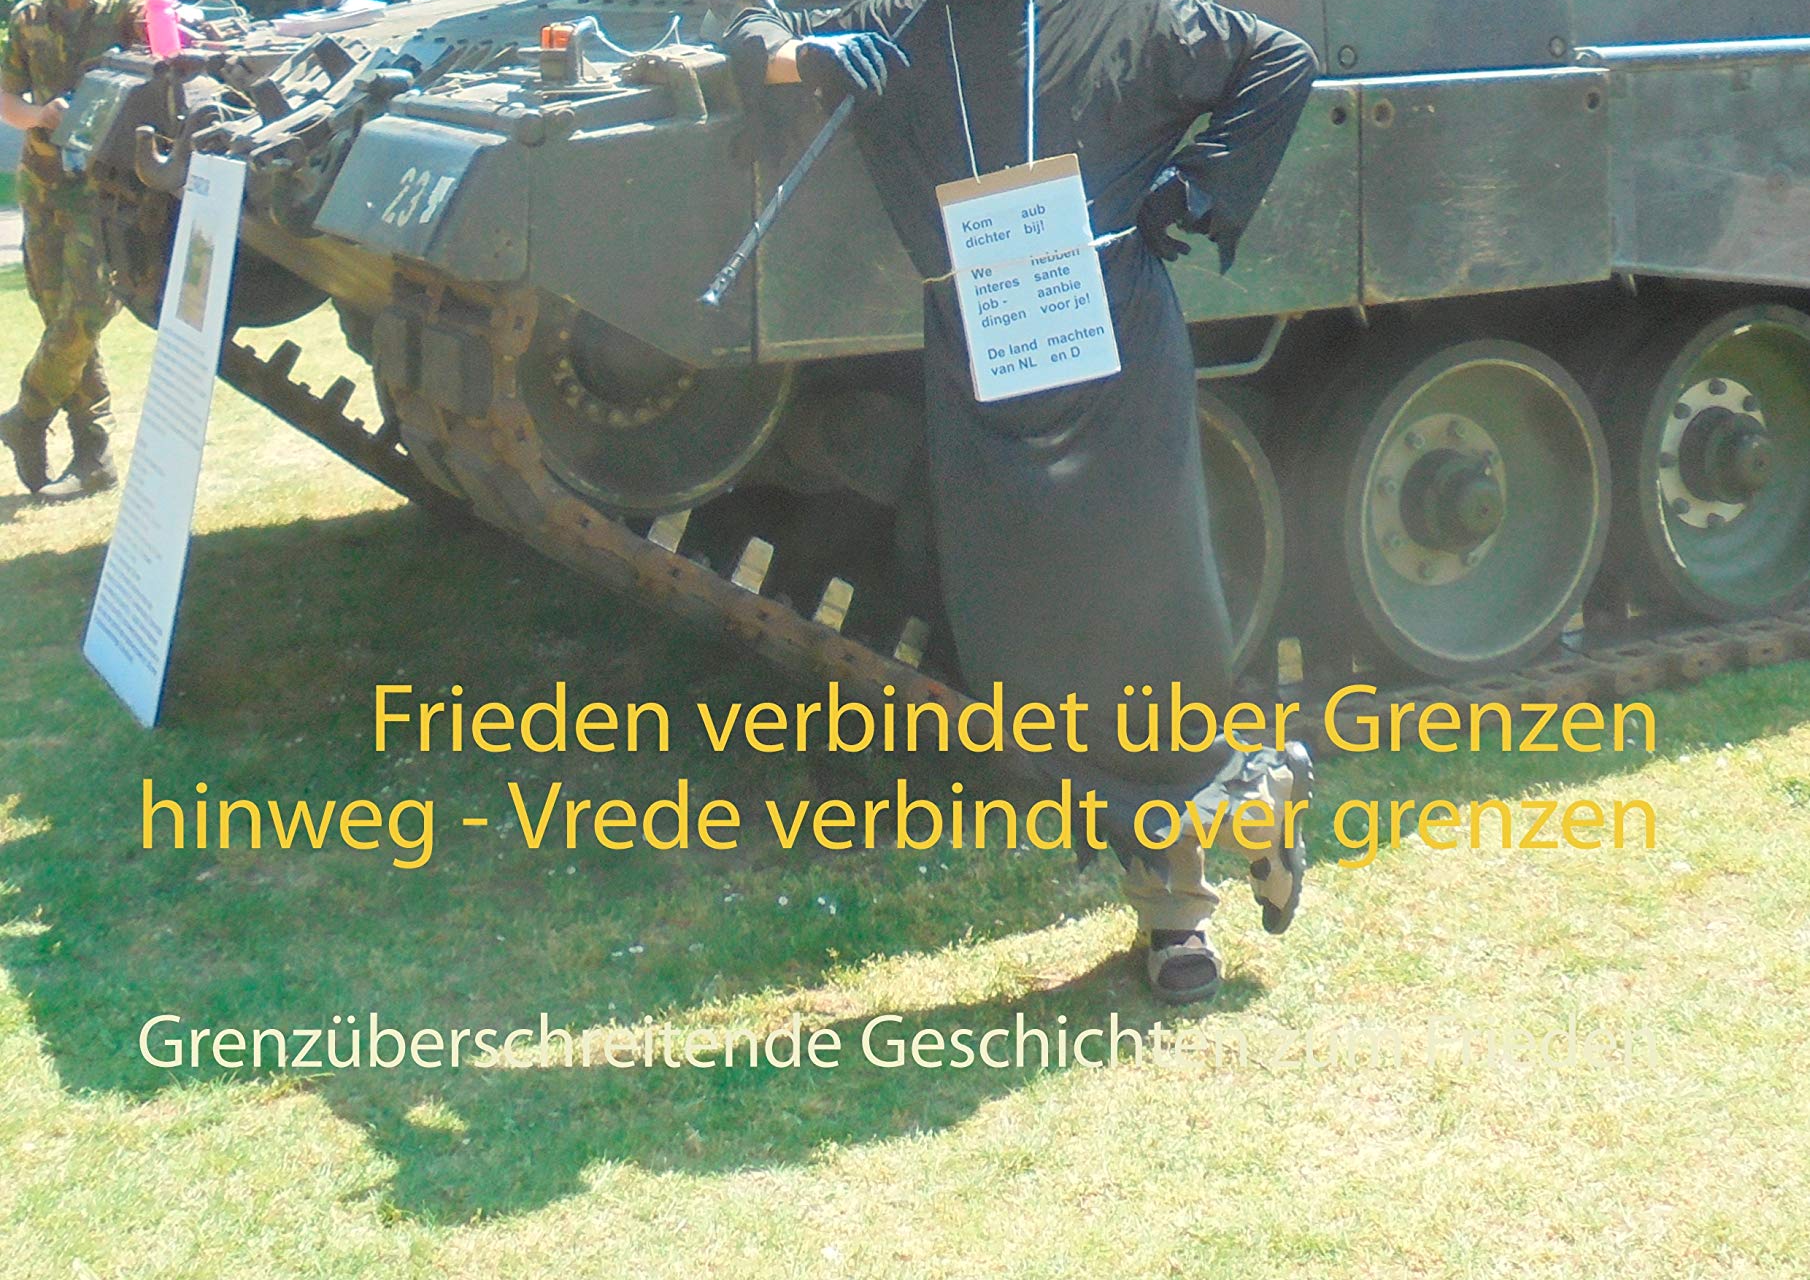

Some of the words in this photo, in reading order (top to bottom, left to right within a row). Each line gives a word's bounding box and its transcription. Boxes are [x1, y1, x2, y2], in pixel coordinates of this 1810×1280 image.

[961, 217, 993, 233] Kom
[1020, 203, 1046, 220] aub
[965, 229, 1011, 249] dichter
[970, 267, 993, 280] We
[974, 278, 1021, 297] interes
[1033, 265, 1071, 282] sante
[1036, 279, 1082, 299] aanbie
[981, 309, 1027, 328] dingen
[1039, 298, 1071, 314] voor
[1073, 292, 1091, 310] je!
[987, 346, 1006, 361] De
[1008, 338, 1039, 356] land
[1046, 325, 1105, 347] machten
[990, 362, 1016, 377] van
[1018, 356, 1038, 371] NL
[1050, 351, 1068, 363] en
[1069, 345, 1081, 359] D
